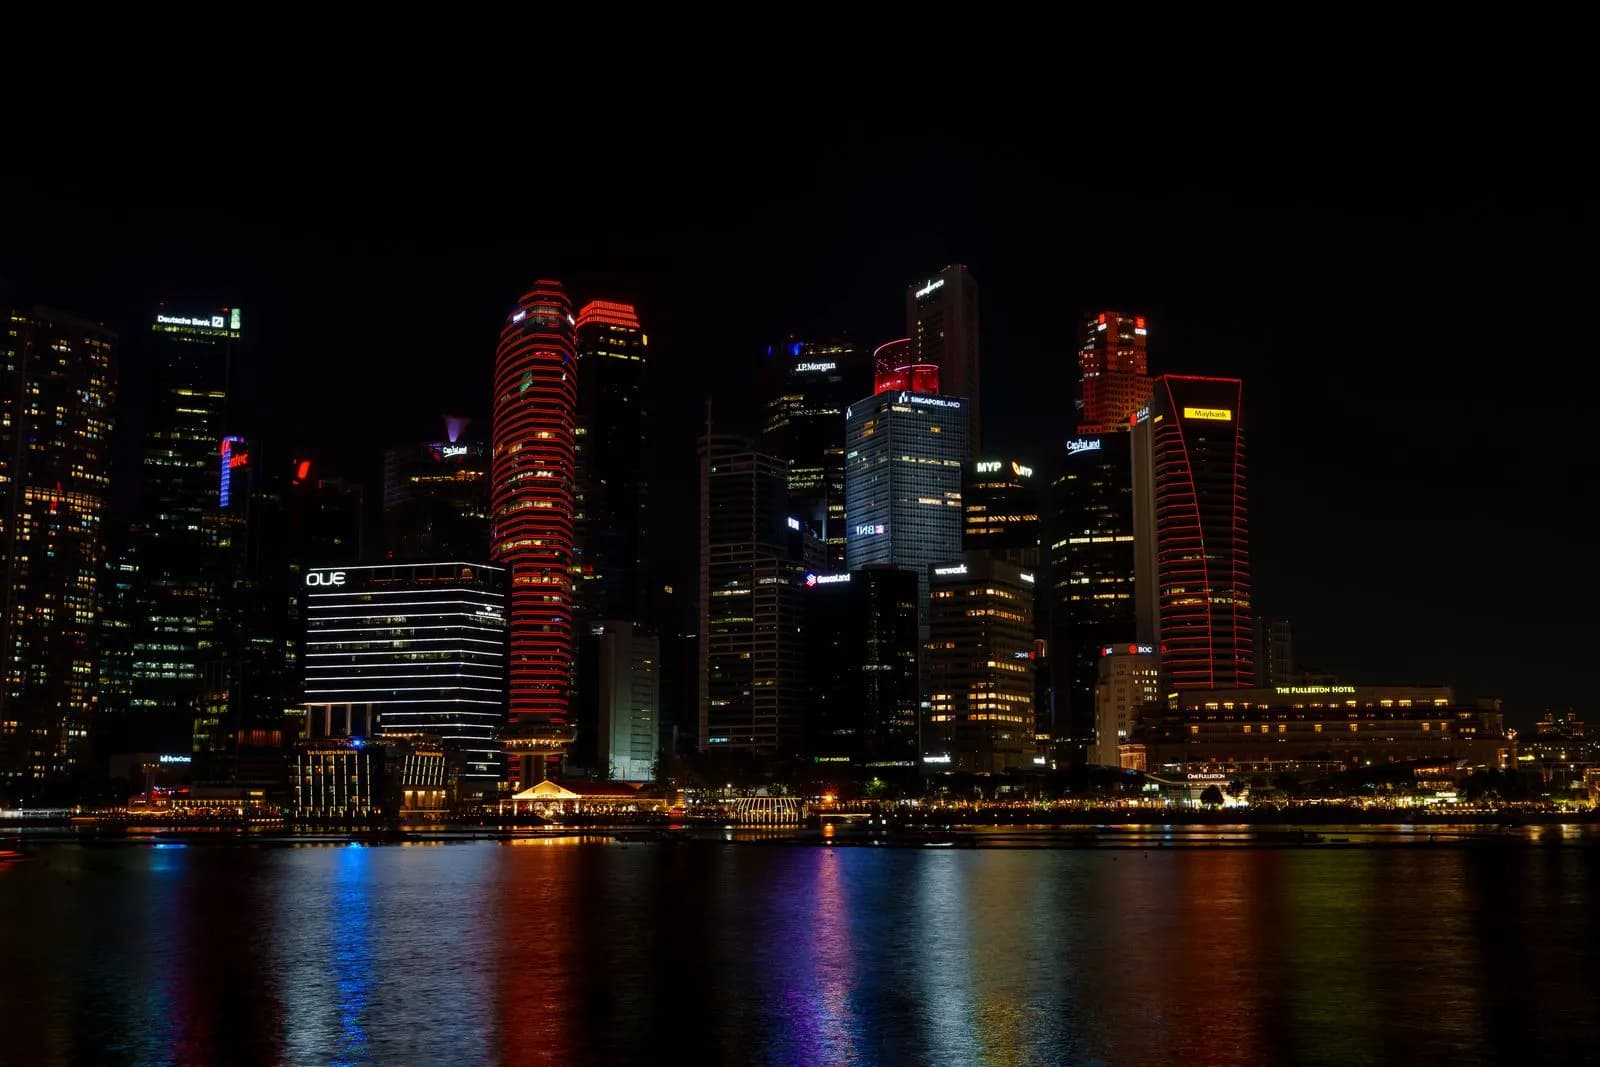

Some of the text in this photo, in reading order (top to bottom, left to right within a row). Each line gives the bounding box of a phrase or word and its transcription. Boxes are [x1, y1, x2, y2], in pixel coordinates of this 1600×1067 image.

[192, 318, 210, 326] Bank
[1194, 410, 1227, 419] Maybank
[977, 462, 1002, 472] MYP
[306, 571, 346, 586] OUE
[1291, 686, 1330, 694] FULLERTON
